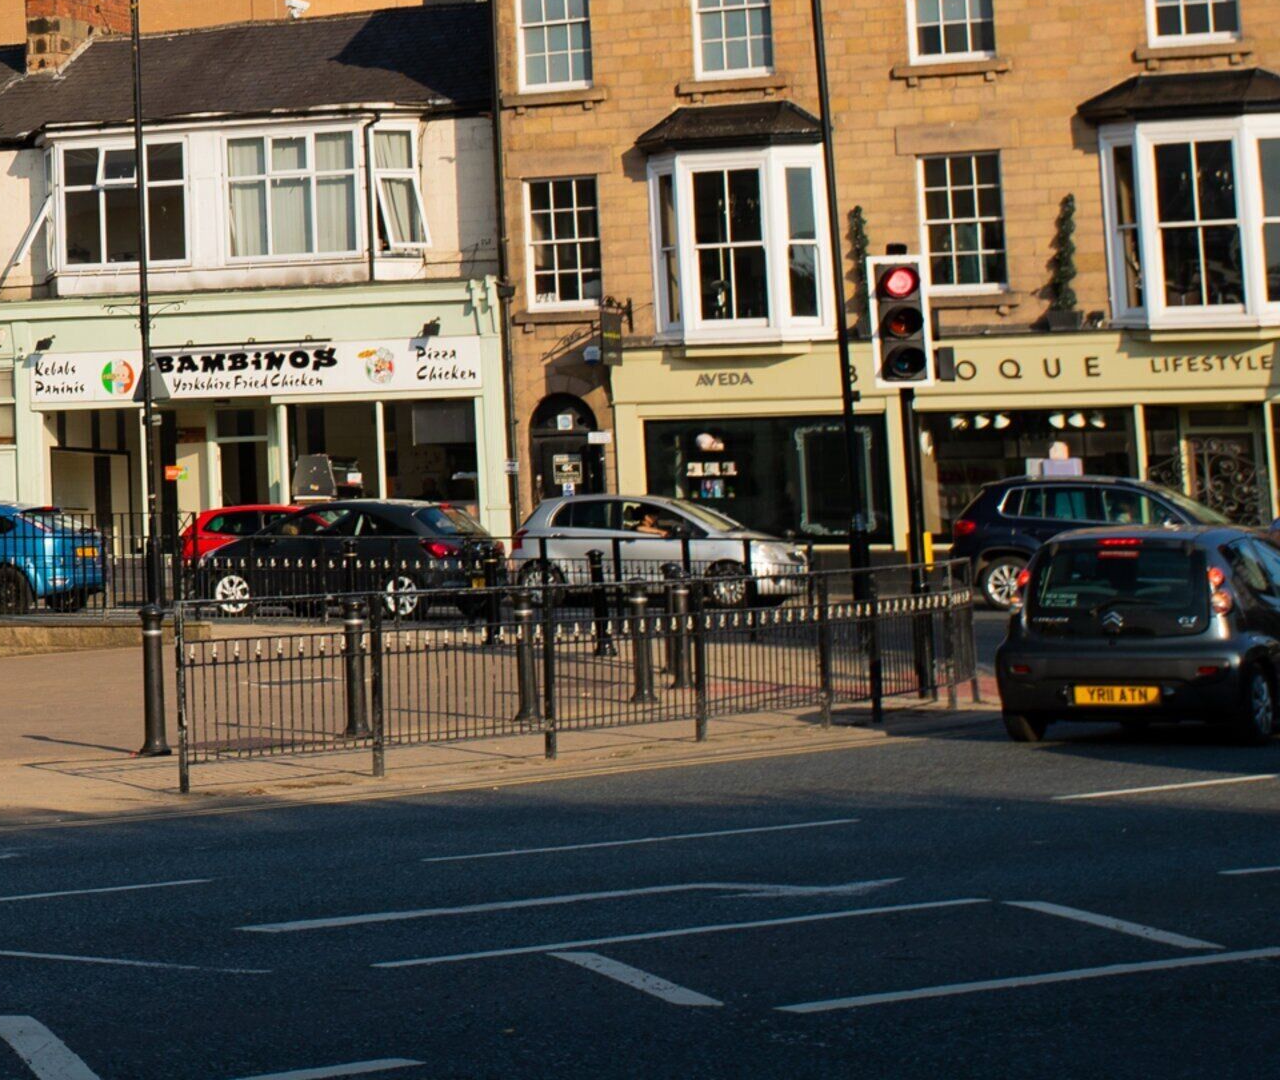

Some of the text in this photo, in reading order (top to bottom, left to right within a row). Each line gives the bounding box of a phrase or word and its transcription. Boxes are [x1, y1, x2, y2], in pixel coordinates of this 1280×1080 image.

[415, 345, 457, 361] Pizza
[34, 361, 76, 377] Kebabs
[1150, 354, 1274, 374] LIFESTYLE
[416, 365, 477, 382] Chicken
[695, 372, 753, 386] AVEDA
[34, 380, 85, 395] Paninis
[173, 373, 323, 393] Yorkshire Fried Chicken
[1119, 687, 1148, 702] ATN
